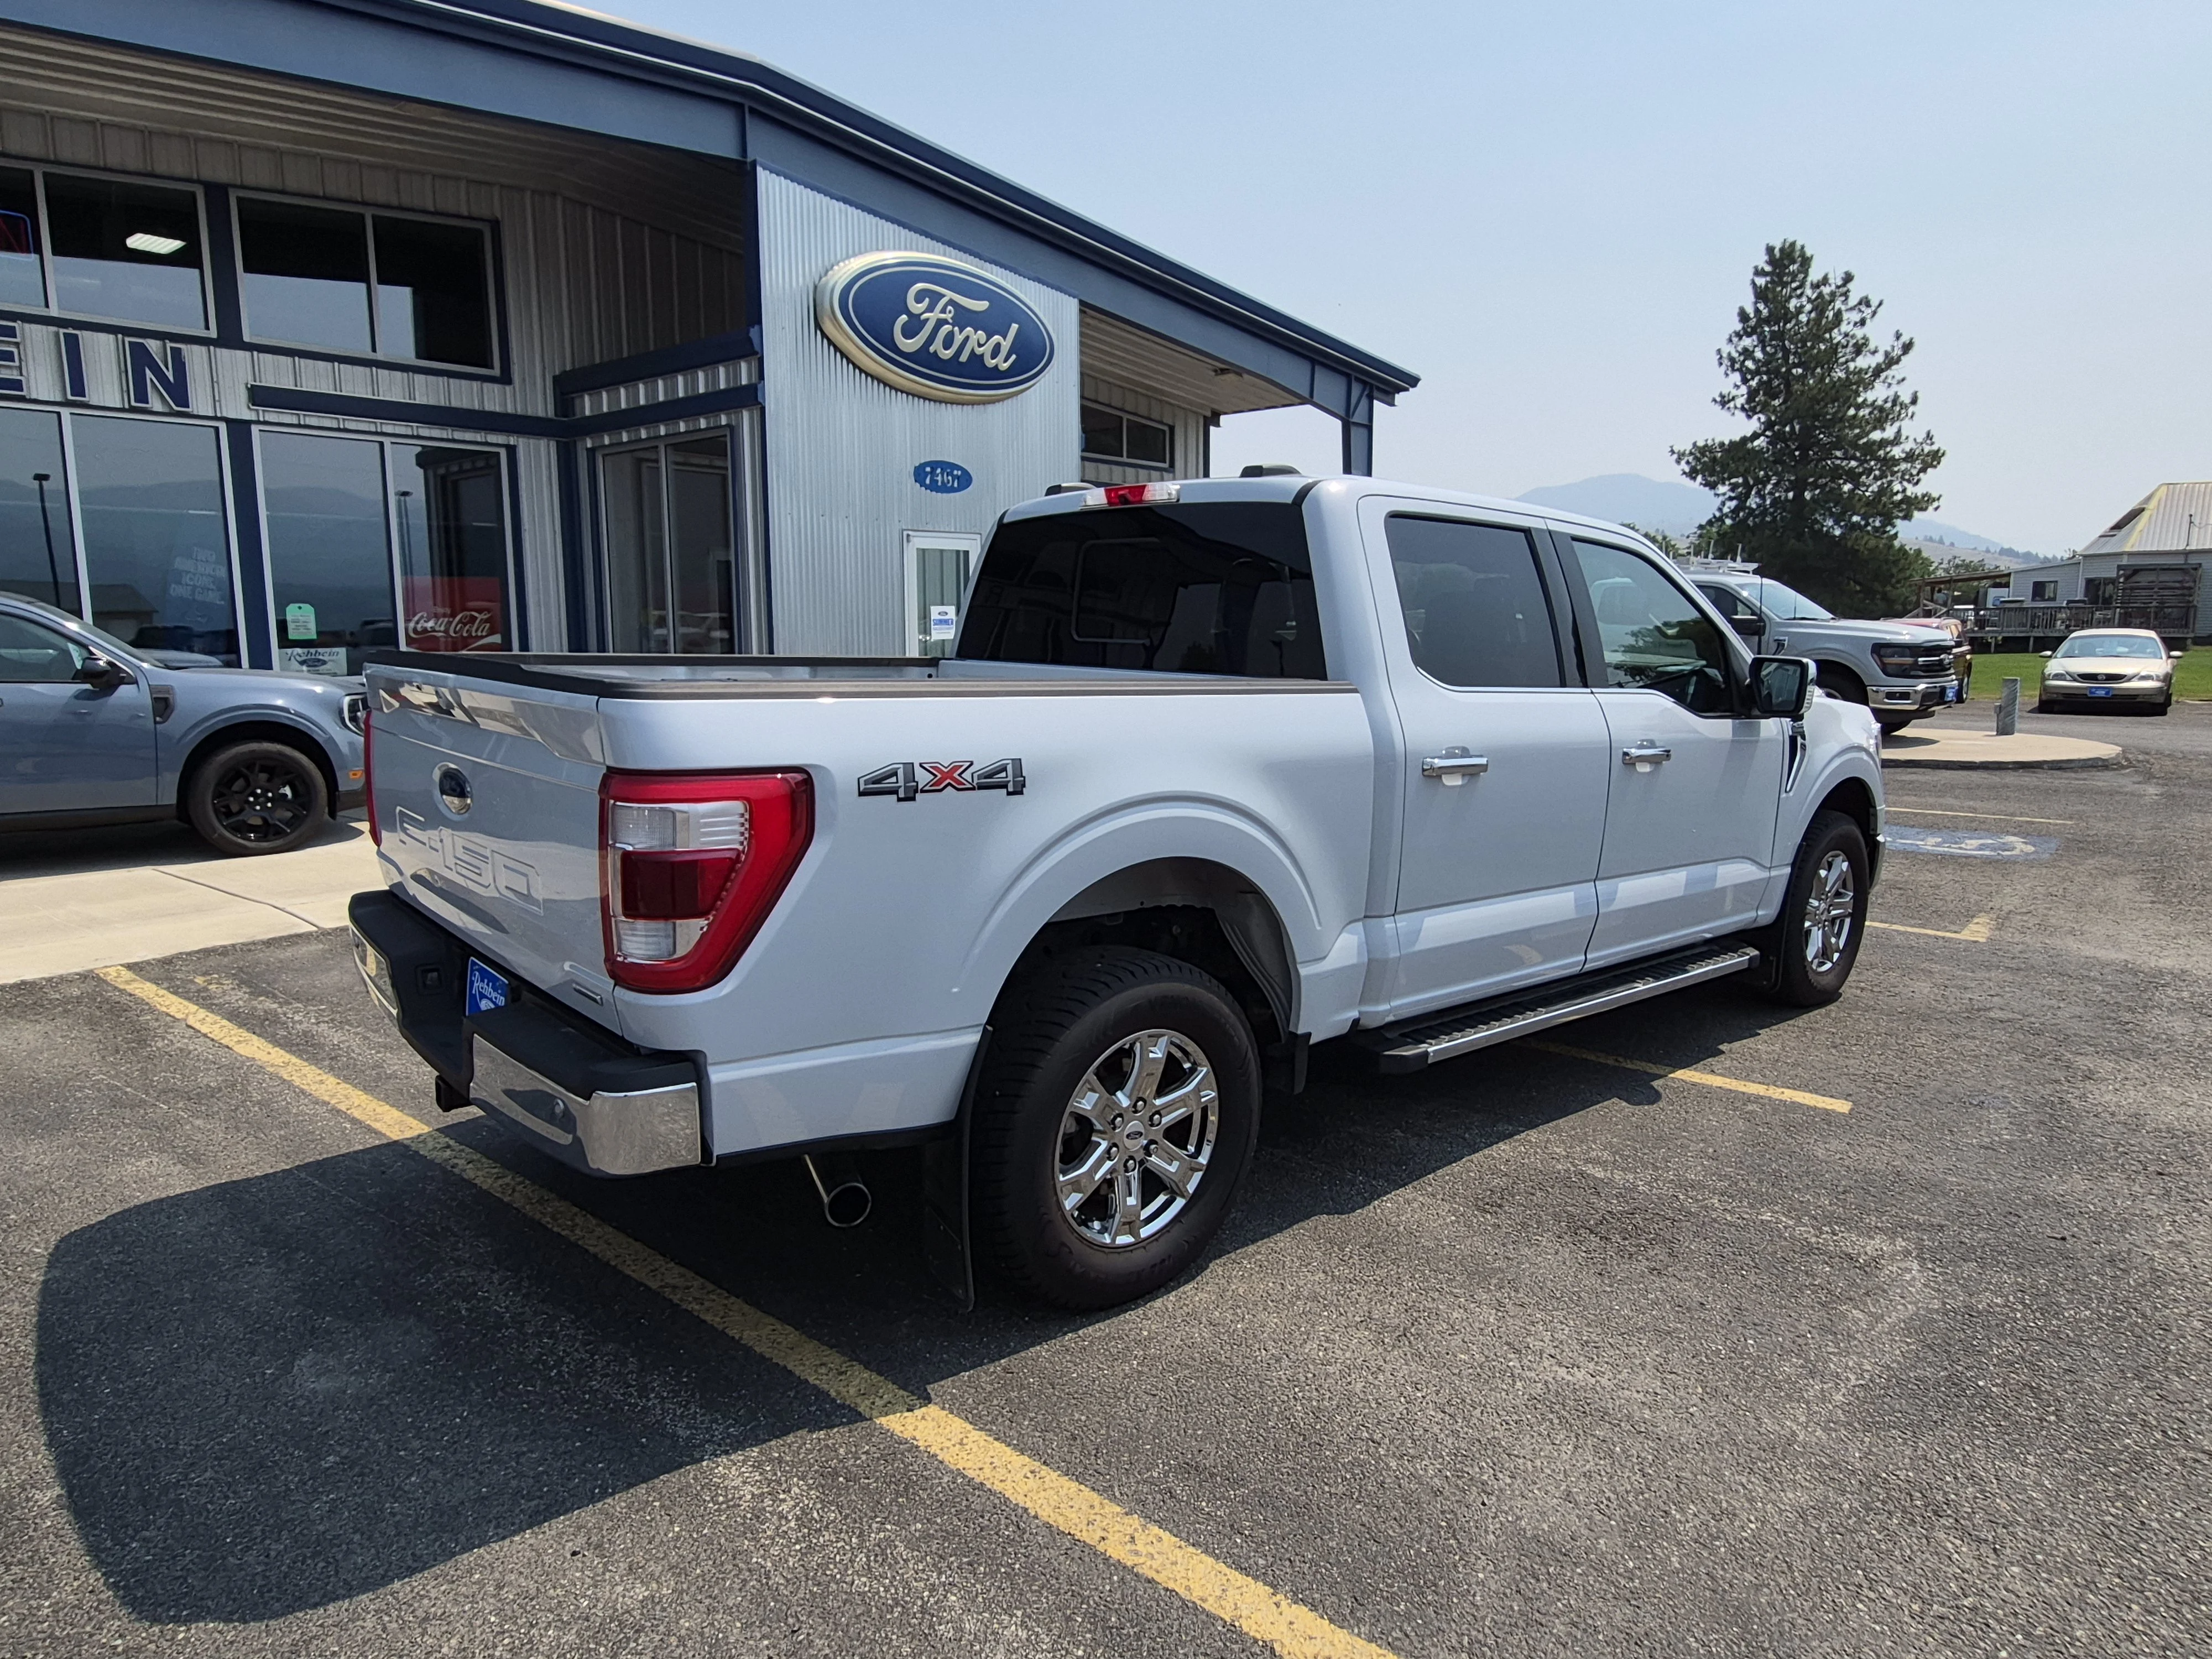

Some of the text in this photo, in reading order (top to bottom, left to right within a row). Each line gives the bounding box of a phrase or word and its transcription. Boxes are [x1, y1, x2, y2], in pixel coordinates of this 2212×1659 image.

[894, 283, 1019, 371] Ford
[925, 467, 961, 488] 7467
[408, 611, 492, 638] Coca-Cola
[396, 805, 544, 916] F-150
[472, 971, 505, 1008] Rehbein
